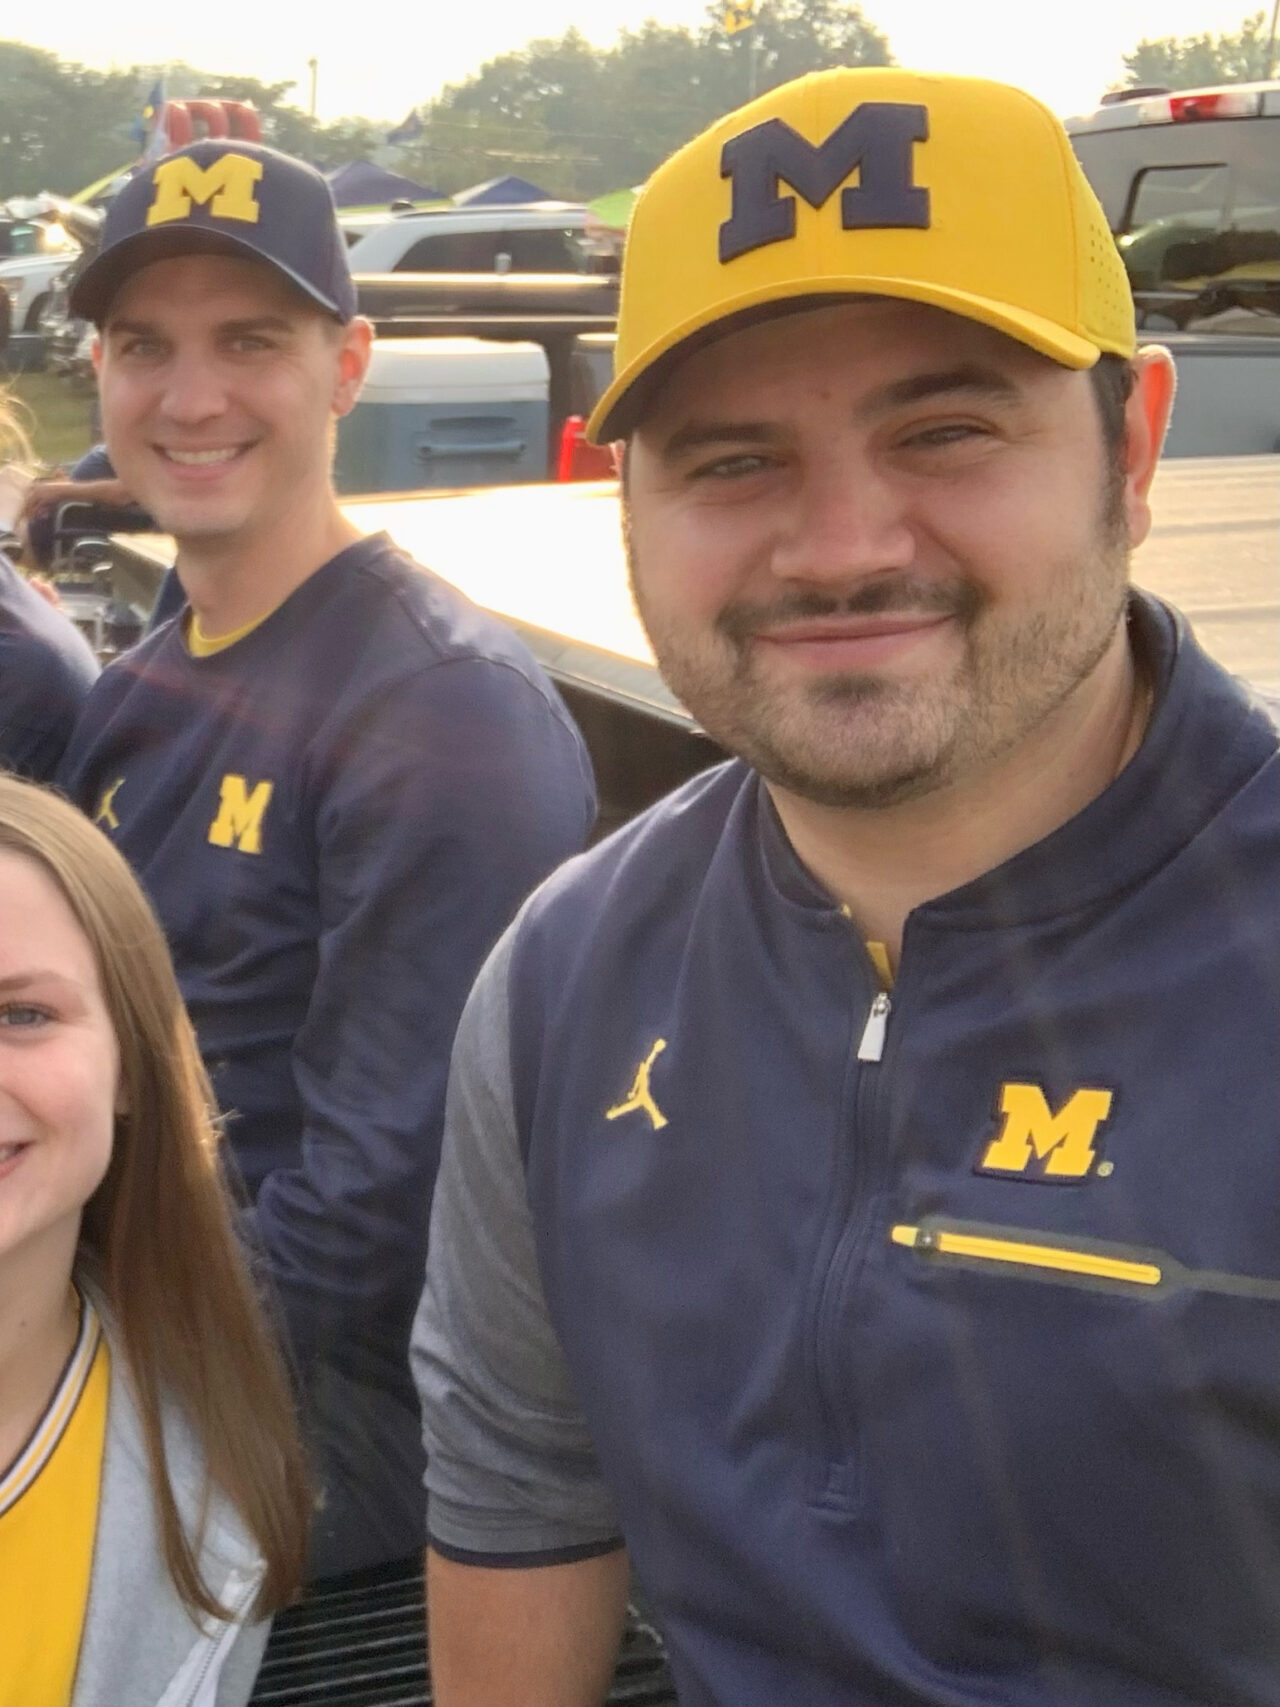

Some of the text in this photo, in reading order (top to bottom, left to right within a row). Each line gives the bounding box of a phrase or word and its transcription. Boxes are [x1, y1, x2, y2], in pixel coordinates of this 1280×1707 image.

[146, 153, 263, 227] M
[719, 102, 930, 265] M
[207, 773, 275, 855] M
[981, 1083, 1114, 1177] M
